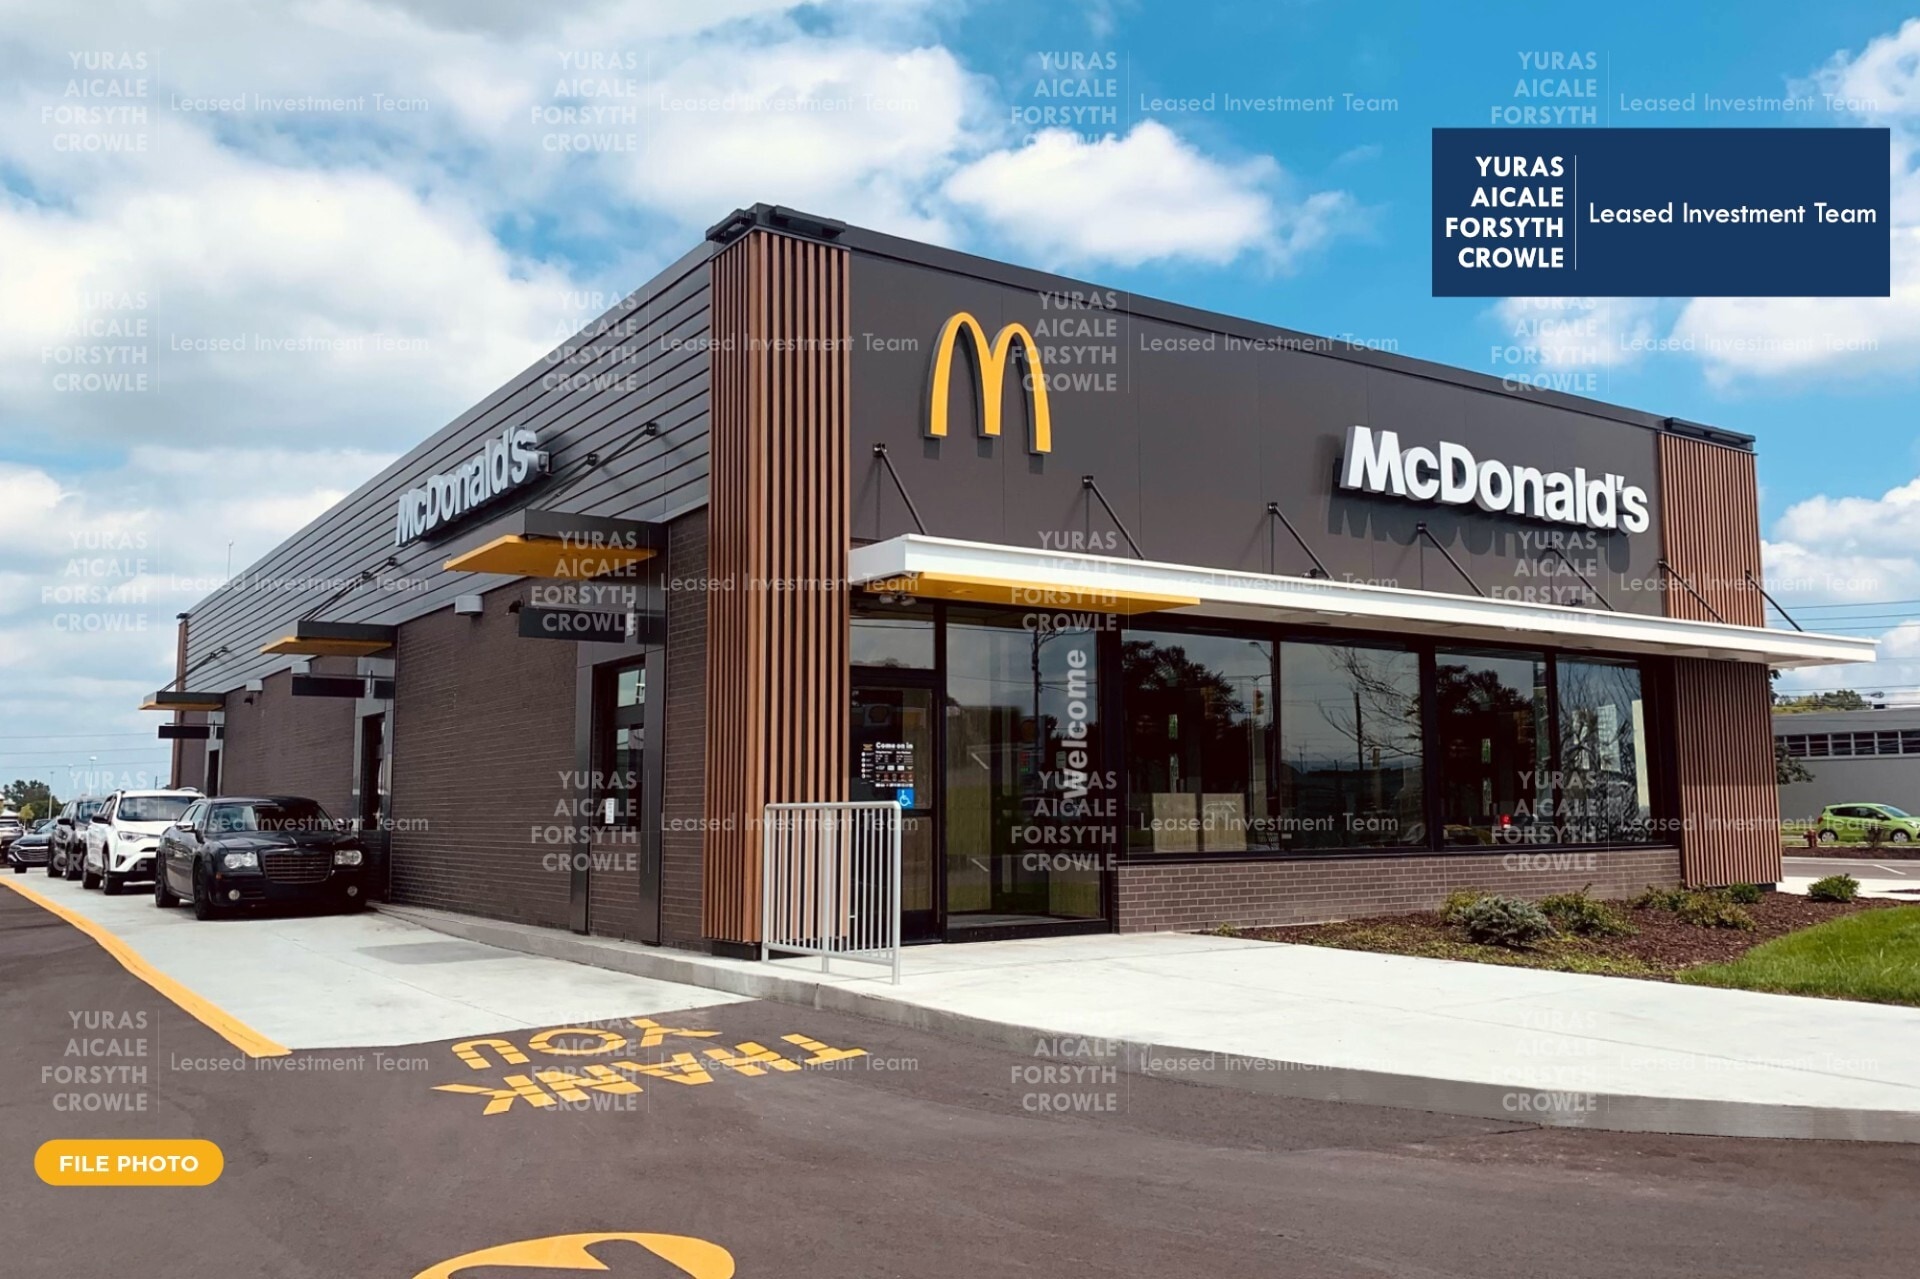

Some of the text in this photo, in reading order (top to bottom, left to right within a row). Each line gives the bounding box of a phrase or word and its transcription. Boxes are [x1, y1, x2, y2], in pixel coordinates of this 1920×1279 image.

[395, 426, 538, 547] McDonald's
[1340, 425, 1650, 533] McDonald's
[1061, 650, 1088, 800] Welcome
[431, 1033, 869, 1116] THANK
[451, 1018, 723, 1070] YOU
